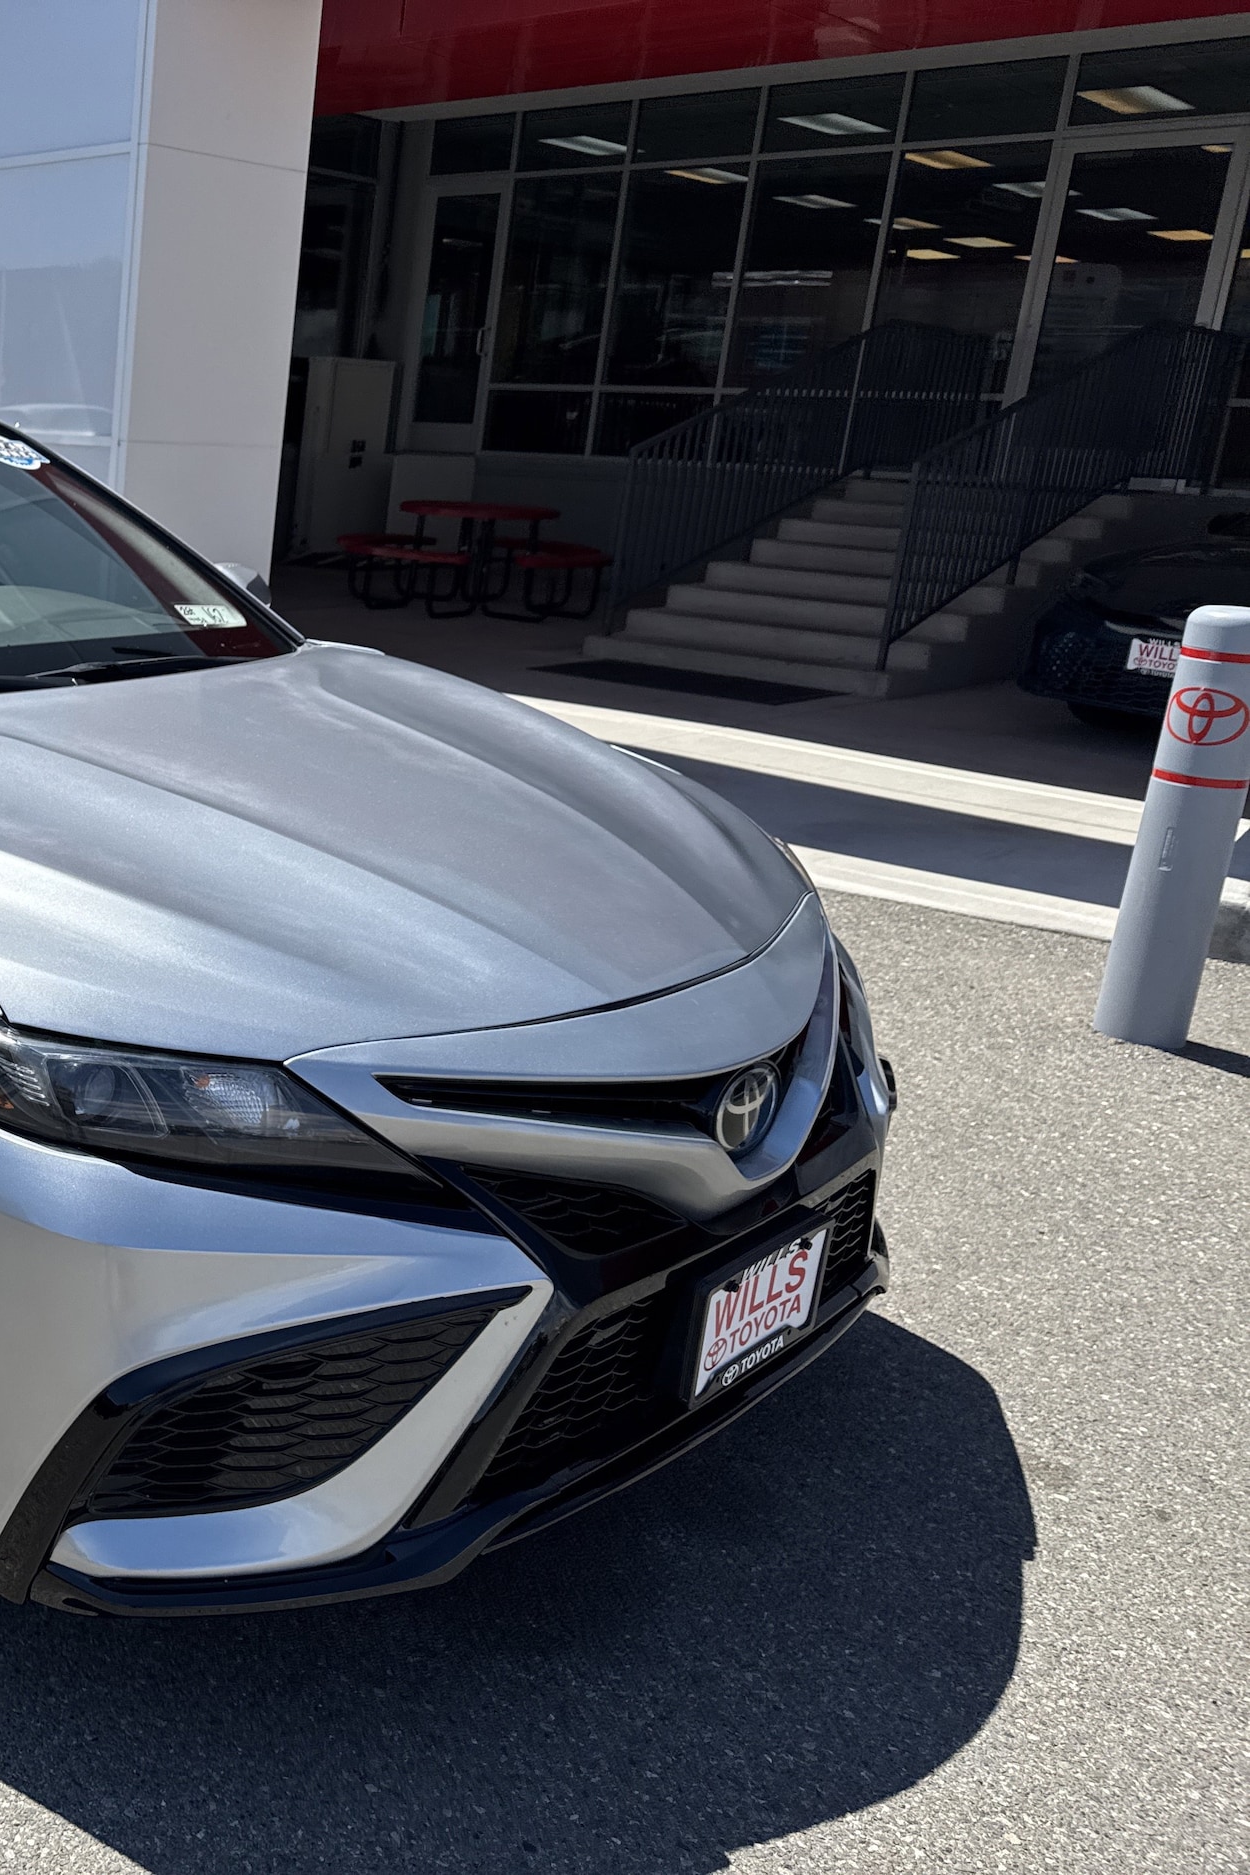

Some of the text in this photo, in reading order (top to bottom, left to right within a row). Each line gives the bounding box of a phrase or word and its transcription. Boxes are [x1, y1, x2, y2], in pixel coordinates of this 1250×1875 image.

[1139, 643, 1178, 662] WILL
[1149, 659, 1177, 671] TOYO
[714, 1250, 809, 1338] WILLS
[730, 1293, 801, 1353] TOYOTA
[741, 1335, 784, 1373] TOYOTA
